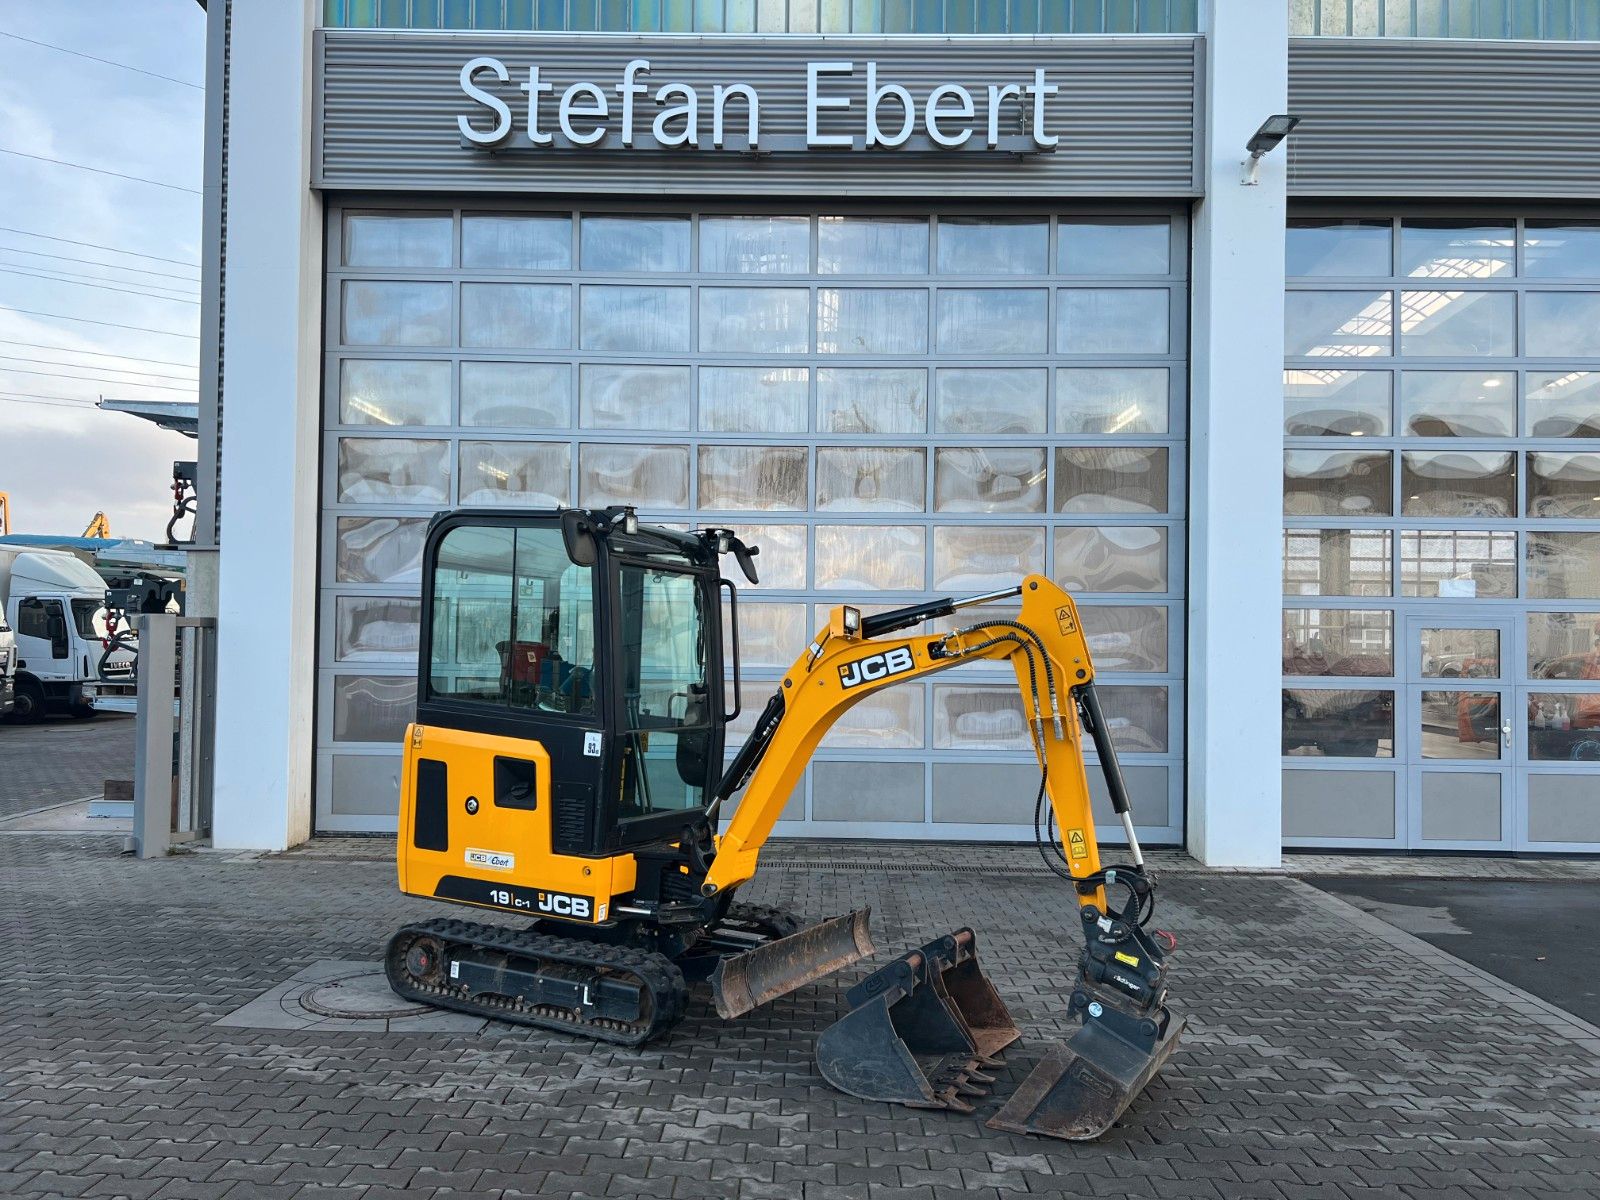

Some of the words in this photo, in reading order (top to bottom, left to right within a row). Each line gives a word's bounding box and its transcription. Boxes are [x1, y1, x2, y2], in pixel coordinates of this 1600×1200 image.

[457, 56, 759, 149] Stefan
[806, 61, 1059, 150] Ebert
[842, 648, 913, 687] JCB
[470, 853, 487, 863] JCB
[489, 890, 509, 905] 19
[538, 893, 590, 918] JCB
